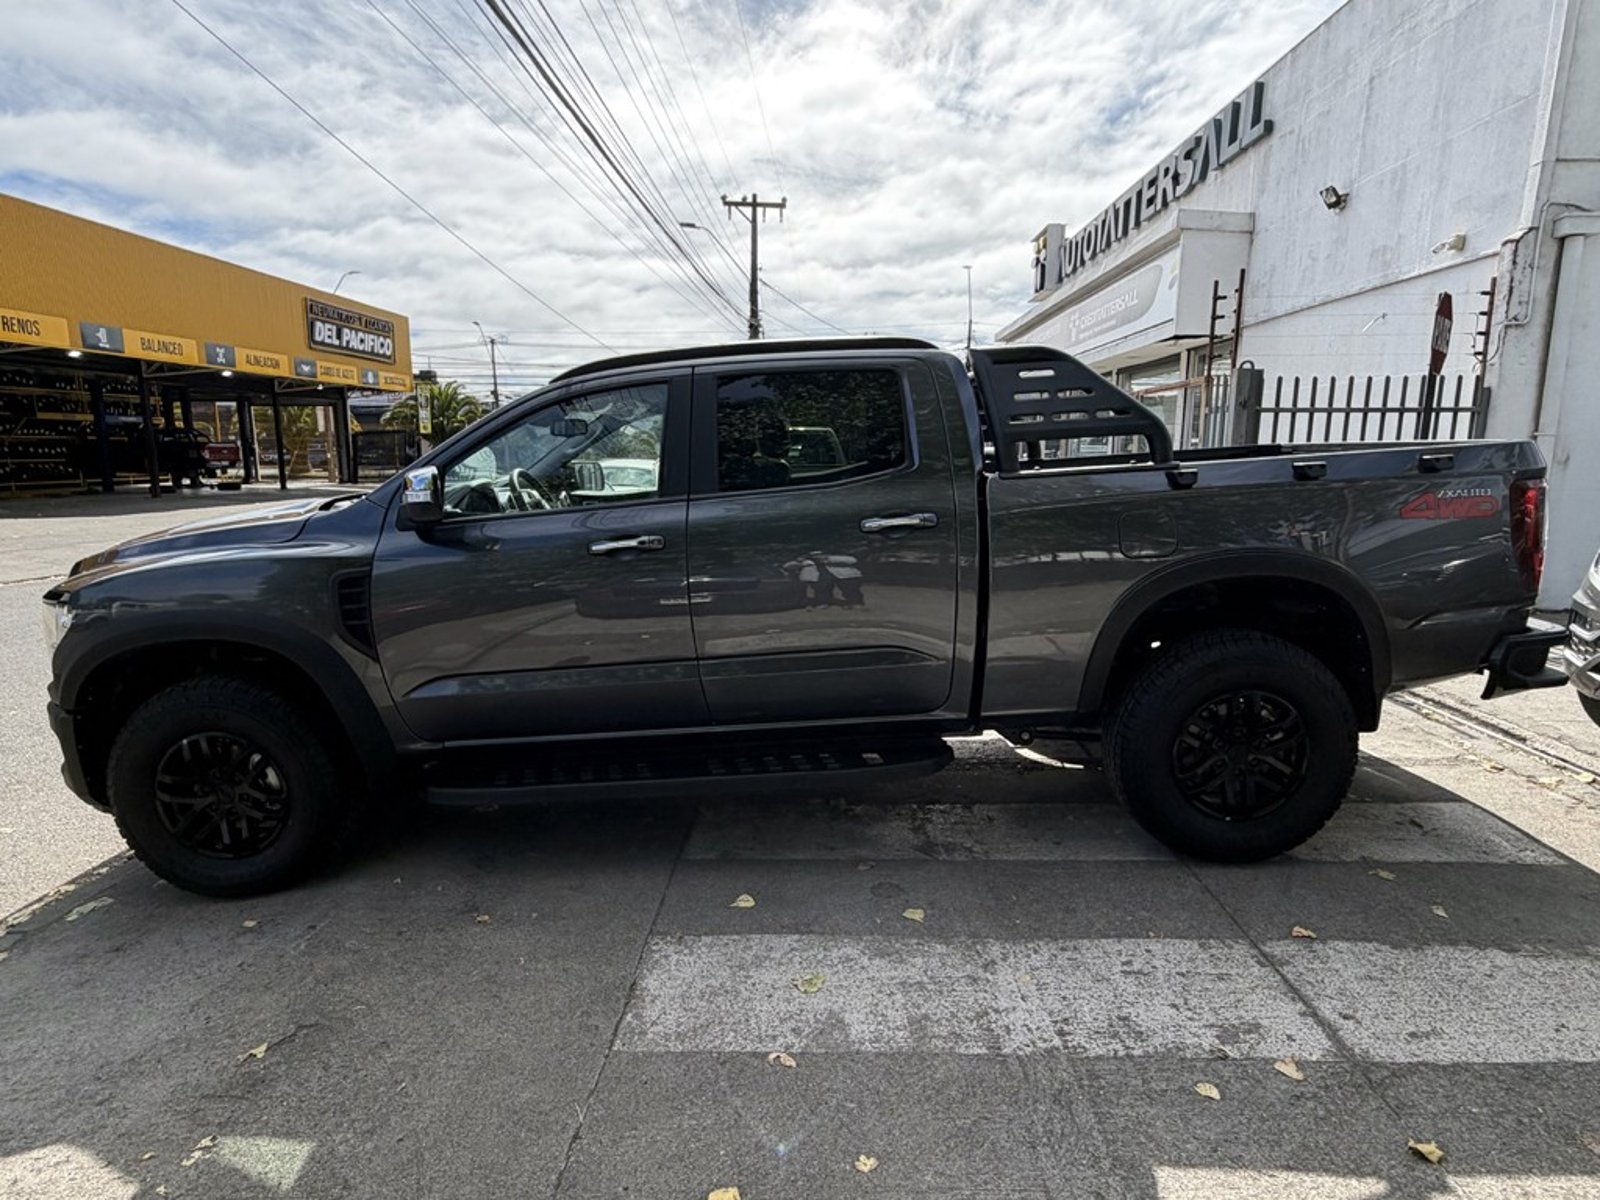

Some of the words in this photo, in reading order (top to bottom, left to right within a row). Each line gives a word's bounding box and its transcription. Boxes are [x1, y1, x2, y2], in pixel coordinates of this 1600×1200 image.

[1058, 81, 1273, 283] AUTOTATTERSALL
[1, 315, 41, 337] RENOS
[315, 321, 339, 345] DEL
[342, 328, 393, 356] PACIFICO
[140, 337, 183, 357] BALANCEO
[1400, 490, 1500, 519] 4WD
